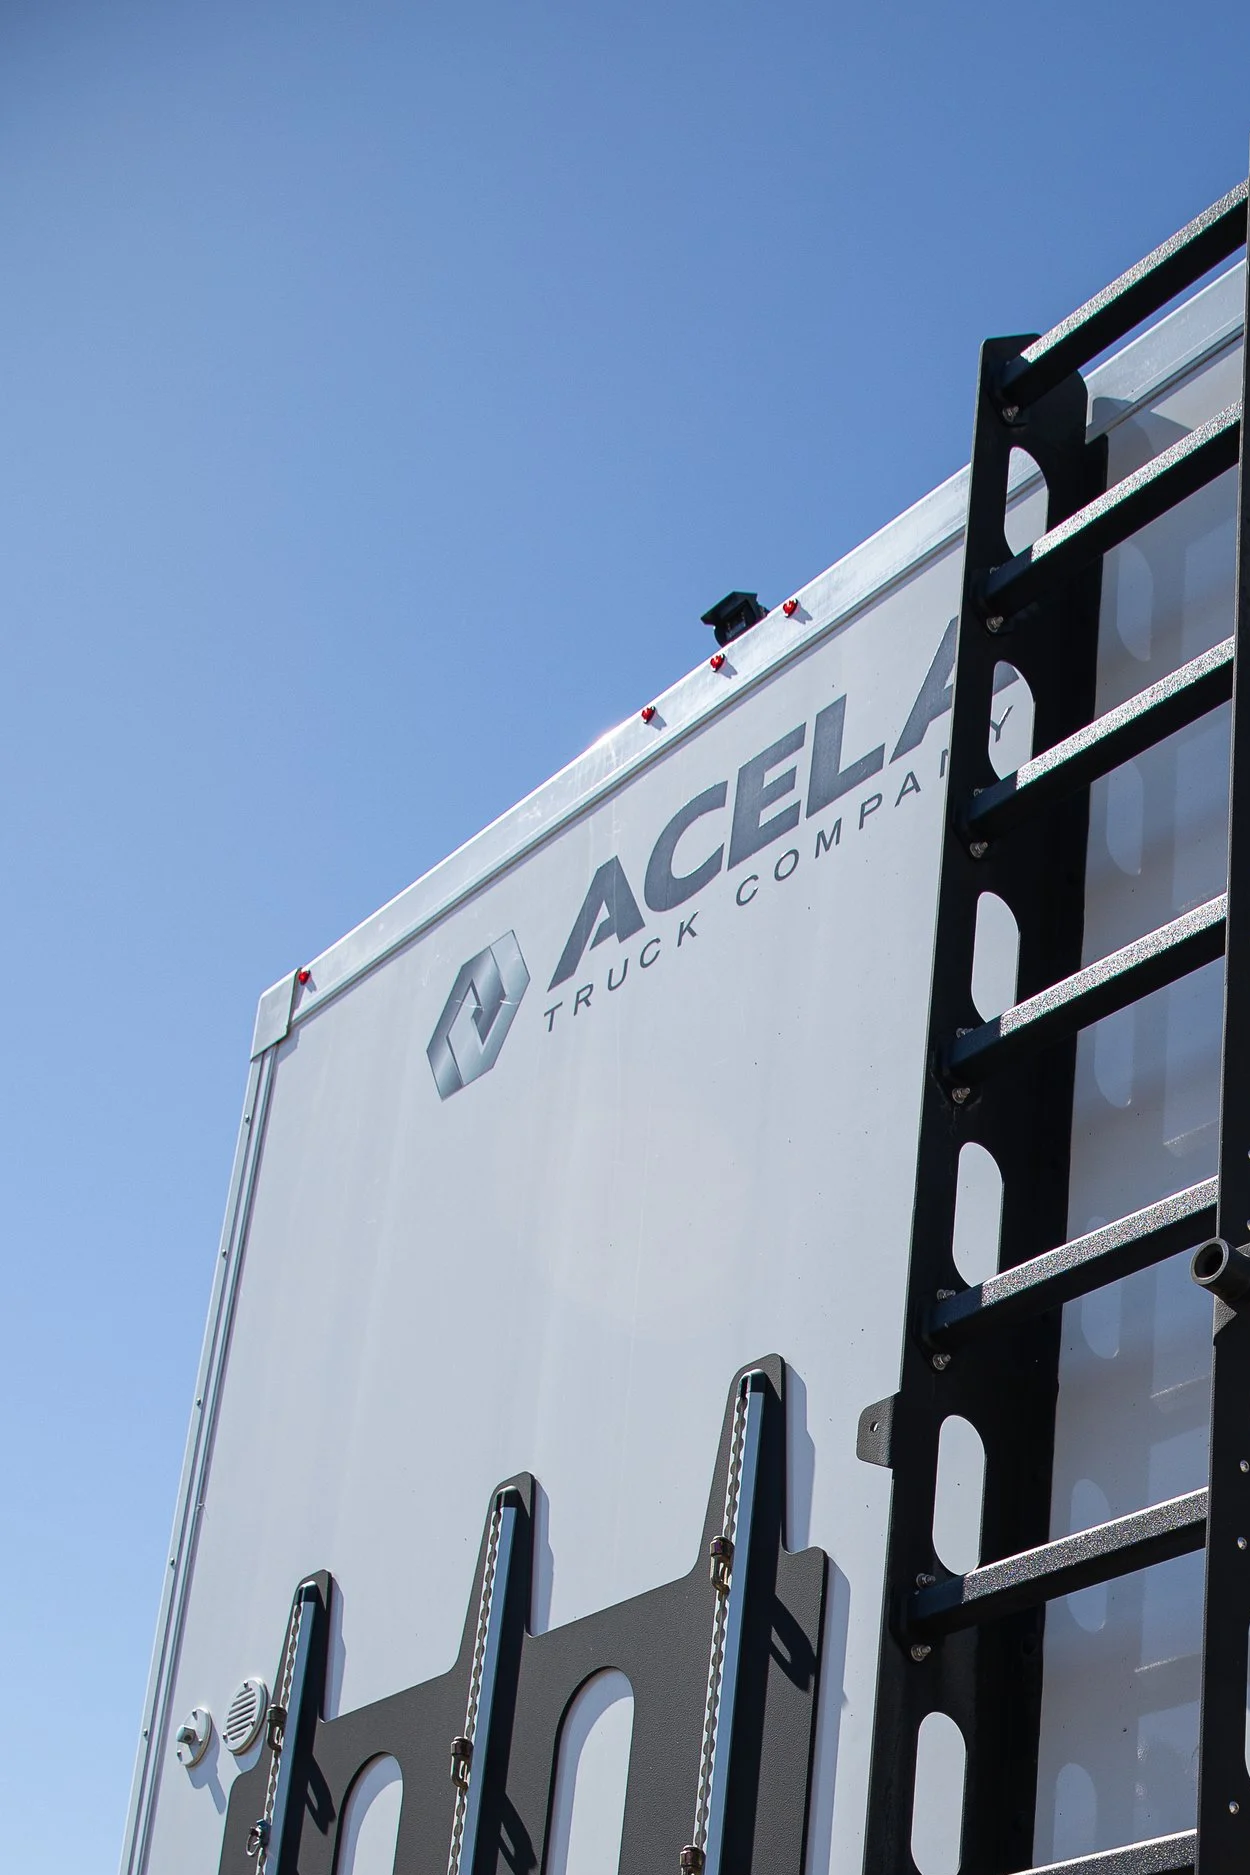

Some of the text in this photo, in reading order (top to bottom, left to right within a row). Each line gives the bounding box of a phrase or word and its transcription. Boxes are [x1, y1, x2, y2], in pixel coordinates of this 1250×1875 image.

[543, 704, 1015, 1033] TRUCK COMPAY
[546, 612, 1021, 992] ACELA
